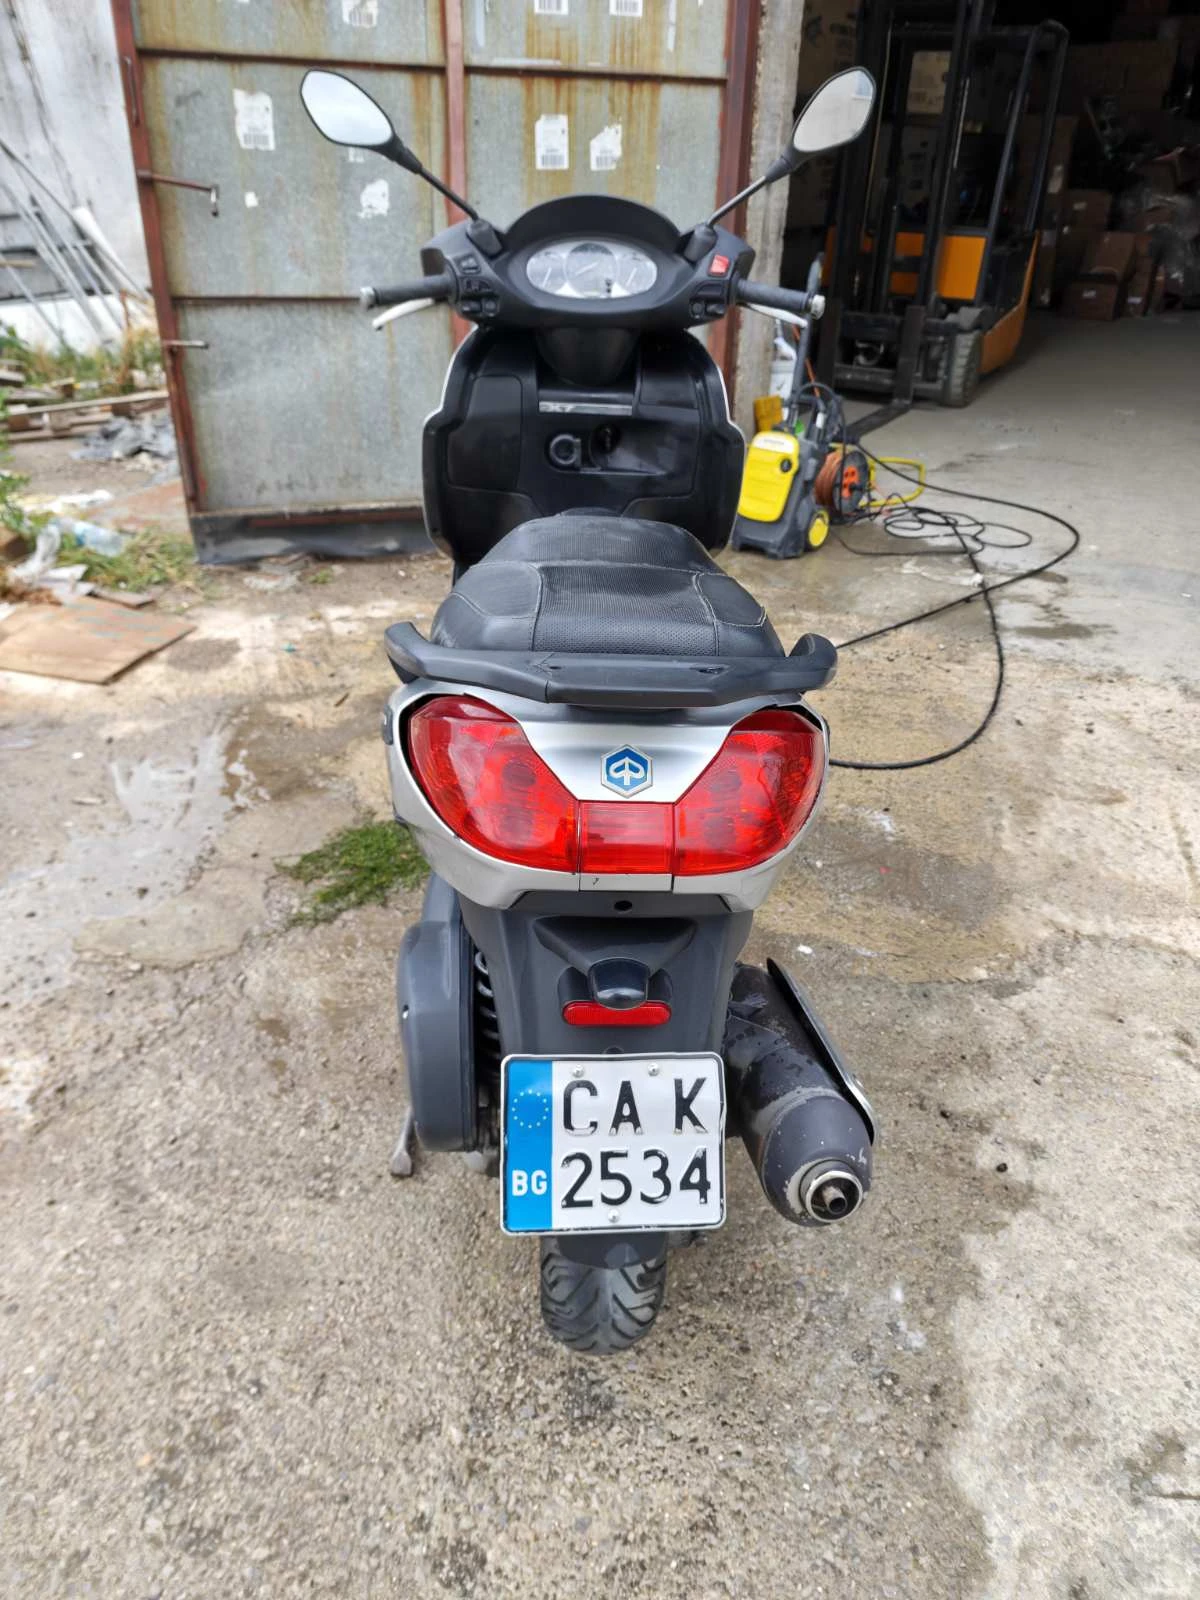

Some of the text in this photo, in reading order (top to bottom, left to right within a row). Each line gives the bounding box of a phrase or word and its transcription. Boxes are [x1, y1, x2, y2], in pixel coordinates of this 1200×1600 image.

[563, 1077, 708, 1136] CA K
[511, 1169, 548, 1196] BG
[561, 1148, 711, 1208] 2534
